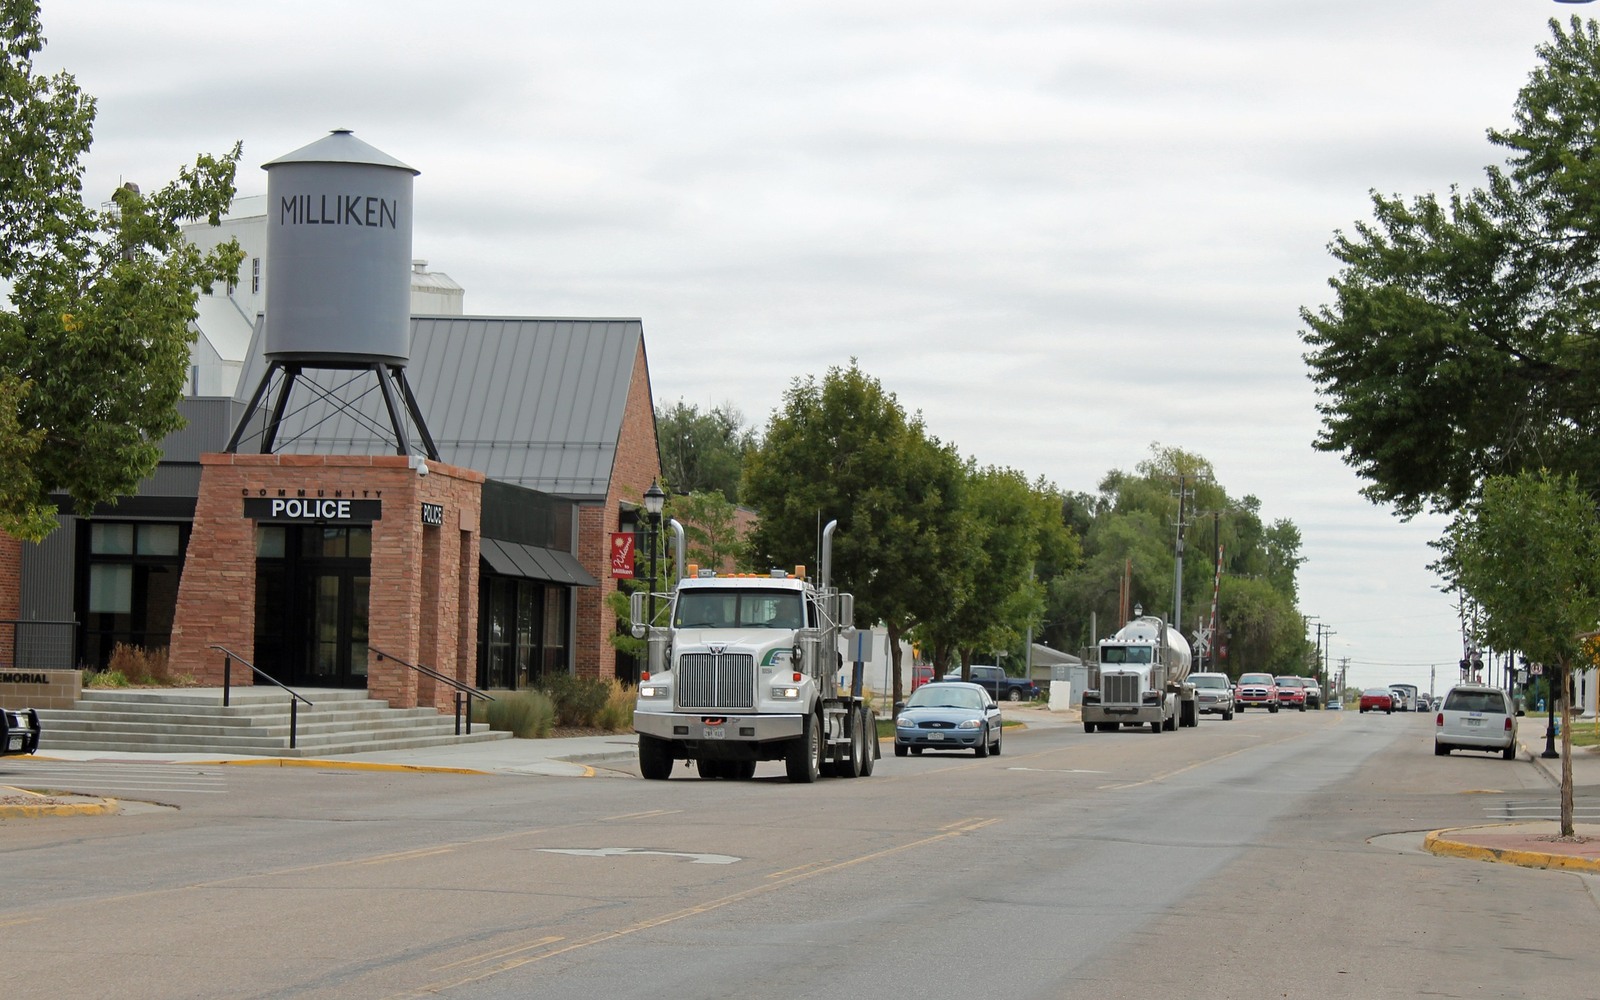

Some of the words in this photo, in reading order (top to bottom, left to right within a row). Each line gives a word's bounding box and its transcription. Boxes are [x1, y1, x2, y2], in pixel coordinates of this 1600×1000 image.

[281, 194, 397, 229] MILLIKEN
[242, 488, 382, 498] COMMUNITY
[271, 500, 351, 518] POLICE
[423, 504, 442, 524] POLICE
